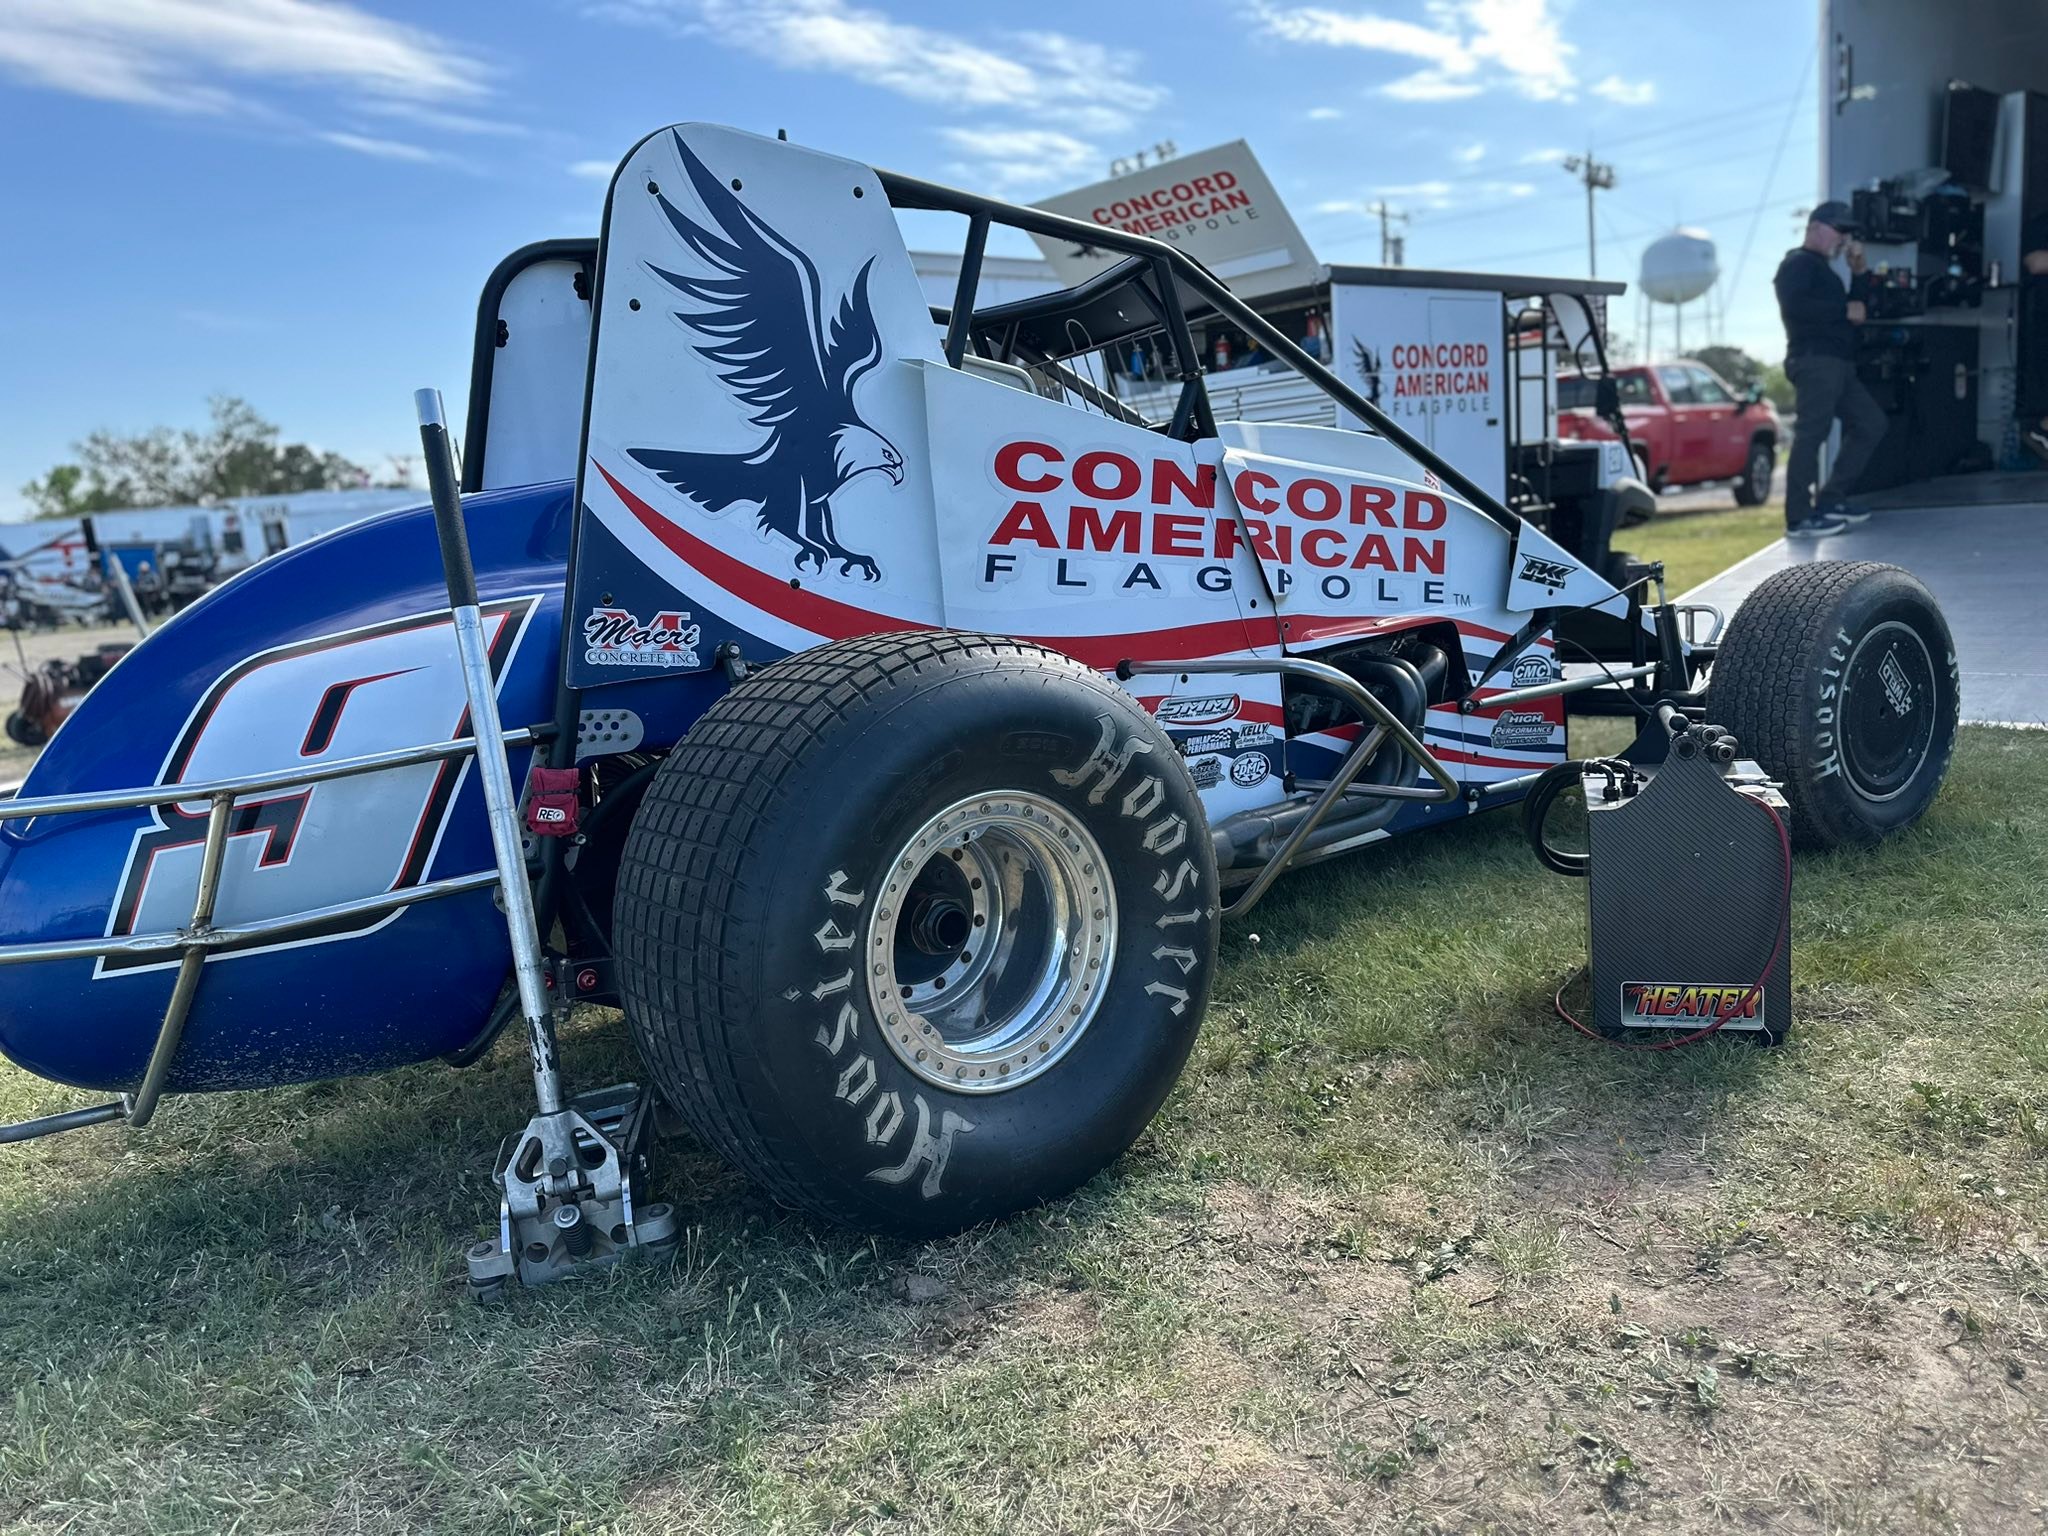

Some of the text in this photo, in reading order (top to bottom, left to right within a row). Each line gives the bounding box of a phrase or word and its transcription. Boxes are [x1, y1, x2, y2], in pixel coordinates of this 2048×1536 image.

[1092, 171, 1237, 226] CONCORD
[1119, 190, 1251, 238] MERICAN
[1392, 344, 1488, 369] CONCORD
[1394, 372, 1489, 397] AMERICAN
[1393, 396, 1490, 416] FLAGPOLE
[993, 441, 1447, 531] CONCORD
[988, 501, 1445, 574] AMERICAN
[985, 553, 1445, 604] FLAGPOLE
[587, 617, 699, 645] Macri
[587, 651, 699, 666] CONCRETE, INC.
[1514, 665, 1547, 679] CMC
[1158, 698, 1233, 716] SMM
[1808, 627, 1852, 782] Hoosier
[1240, 723, 1268, 738] KELLY
[1495, 726, 1552, 735] PERFORMANCE
[1509, 714, 1542, 723] HIGH
[1187, 734, 1213, 745] DUNLAP
[1187, 740, 1231, 755] PERFORMANCE
[1049, 714, 1215, 1016] Hoosier
[782, 869, 976, 1199] Hoosier
